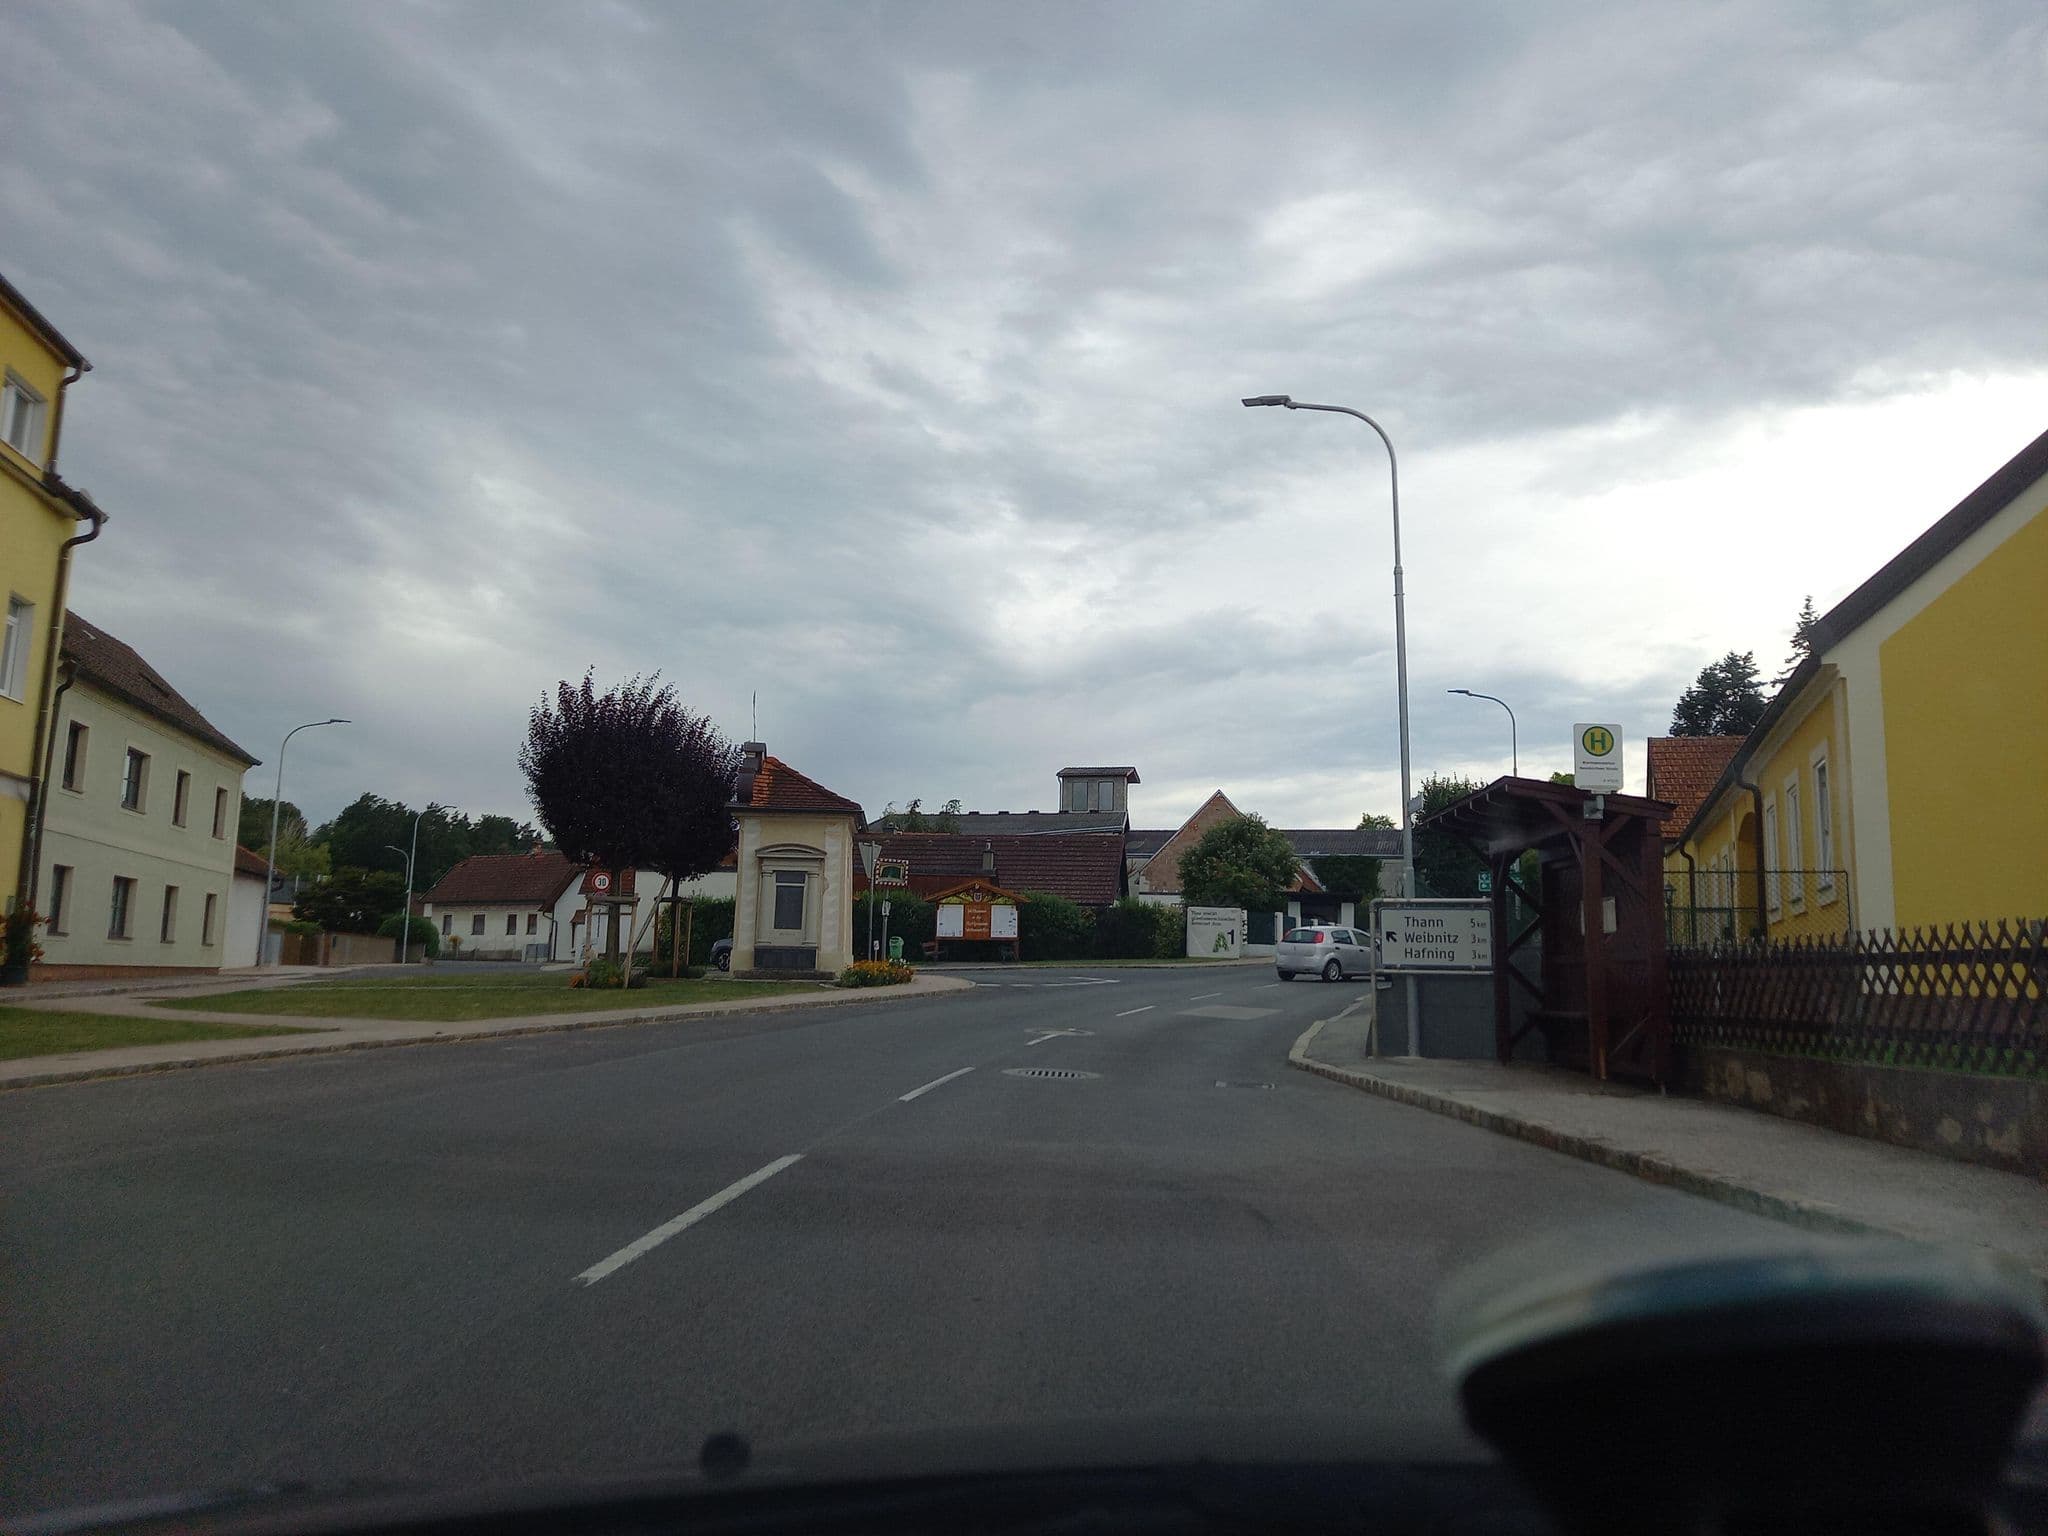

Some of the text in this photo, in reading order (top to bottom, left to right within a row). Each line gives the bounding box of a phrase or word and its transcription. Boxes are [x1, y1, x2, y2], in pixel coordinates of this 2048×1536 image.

[1590, 732, 1606, 751] H
[597, 877, 607, 887] 30
[1404, 916, 1444, 928] Thann
[1404, 931, 1459, 944] Weibnitz
[1404, 947, 1455, 962] Hafning
